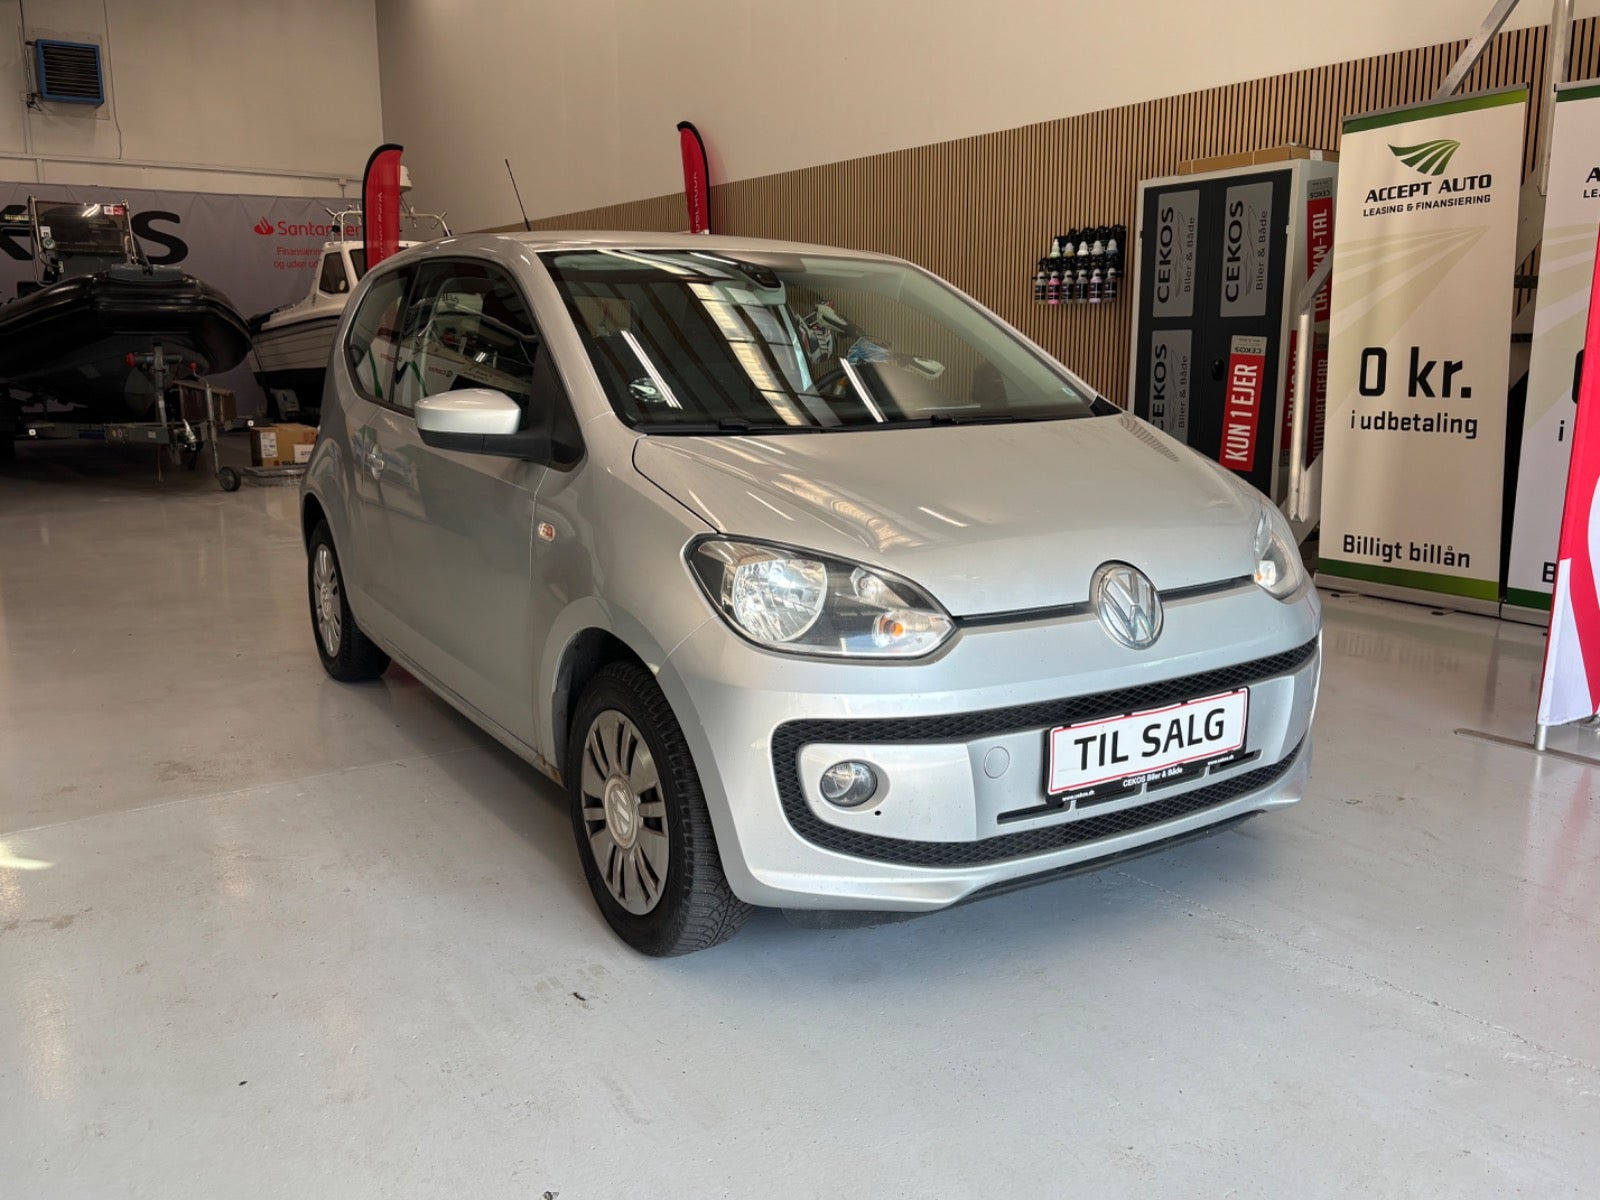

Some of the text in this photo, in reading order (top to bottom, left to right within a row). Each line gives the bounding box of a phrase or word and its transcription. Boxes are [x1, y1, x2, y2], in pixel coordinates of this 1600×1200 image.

[1363, 194, 1491, 217] LEASING & FINANSIERING
[1365, 173, 1492, 204] ACCEPT AUTO
[1157, 206, 1174, 303] CEKOS
[1186, 252, 1193, 261] &
[1225, 200, 1244, 302] CEKOS
[1255, 210, 1268, 290] Biler & Både
[1184, 266, 1192, 293] Biler
[1231, 363, 1258, 406] EJER
[1359, 347, 1387, 397] 0
[1407, 346, 1472, 399] kr.
[1230, 410, 1252, 418] 1
[1350, 410, 1478, 439] i udbetaling
[1225, 423, 1252, 462] KUN
[1343, 534, 1470, 568] Billigt billån
[1074, 708, 1225, 771] TIL SALG
[1122, 775, 1146, 788] CEKOS
